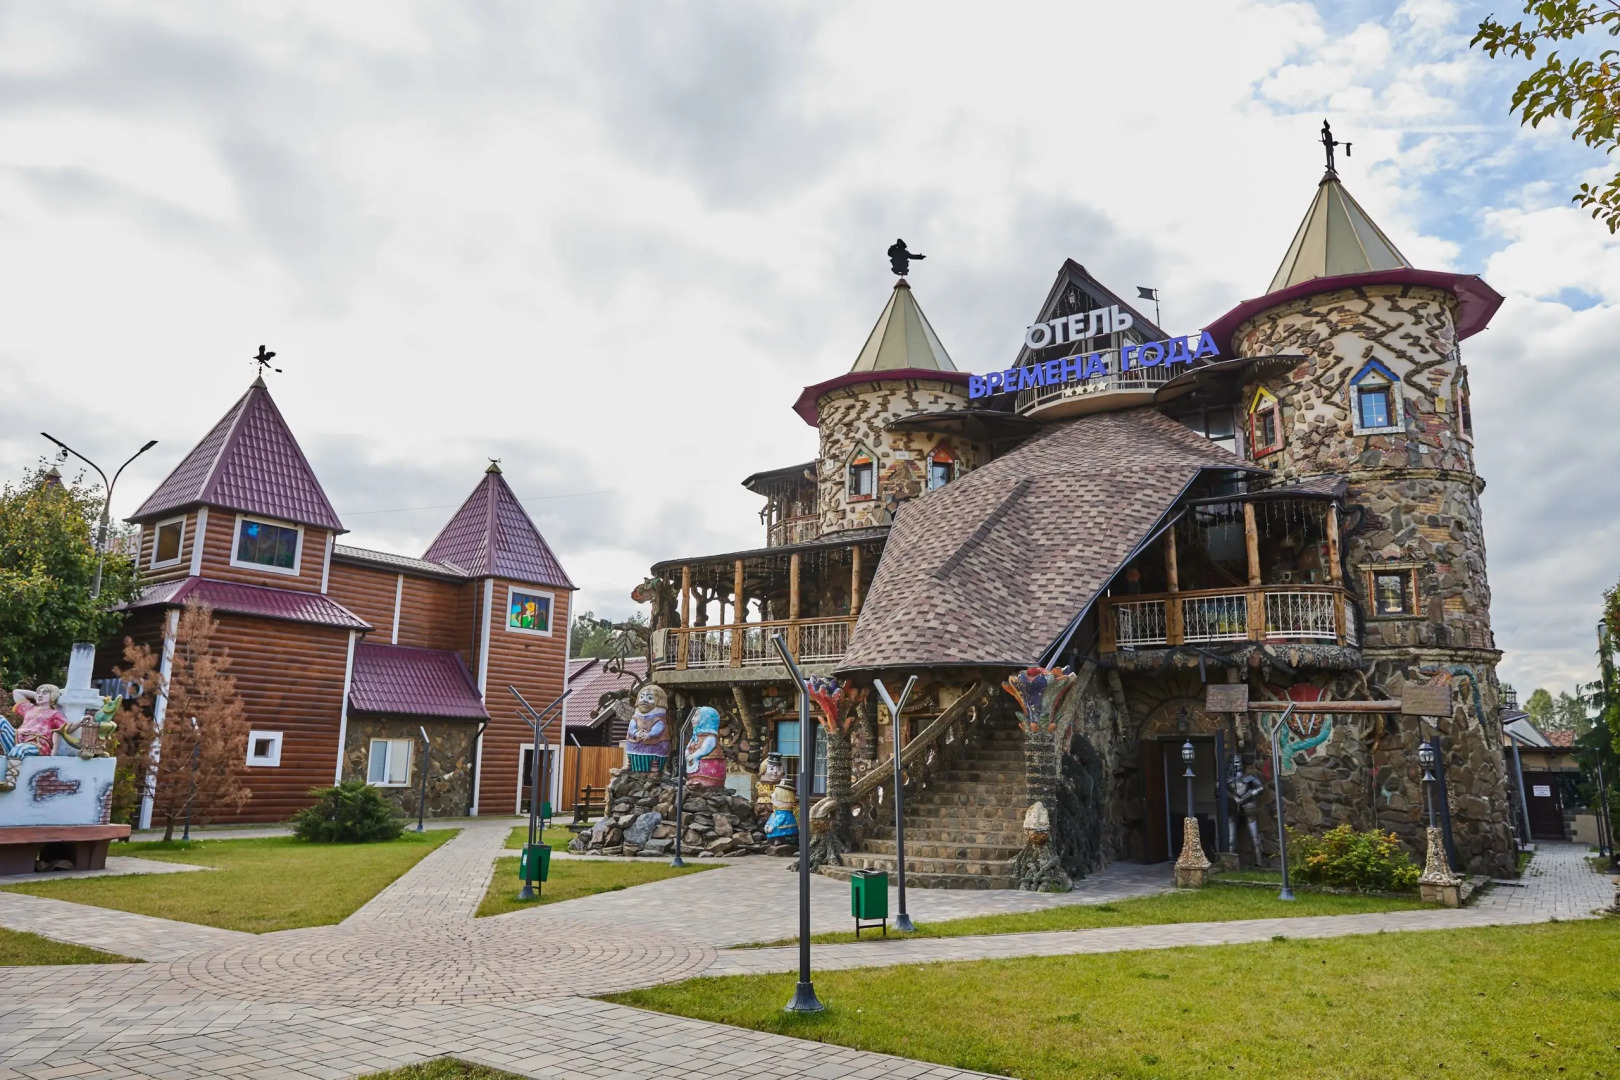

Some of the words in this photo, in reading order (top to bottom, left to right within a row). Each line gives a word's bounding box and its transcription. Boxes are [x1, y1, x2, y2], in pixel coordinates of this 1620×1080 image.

[1025, 305, 1133, 349] ОТЕЛЬ
[969, 352, 1107, 399] ВРЕМЕНА
[1121, 331, 1220, 372] ГОДА
